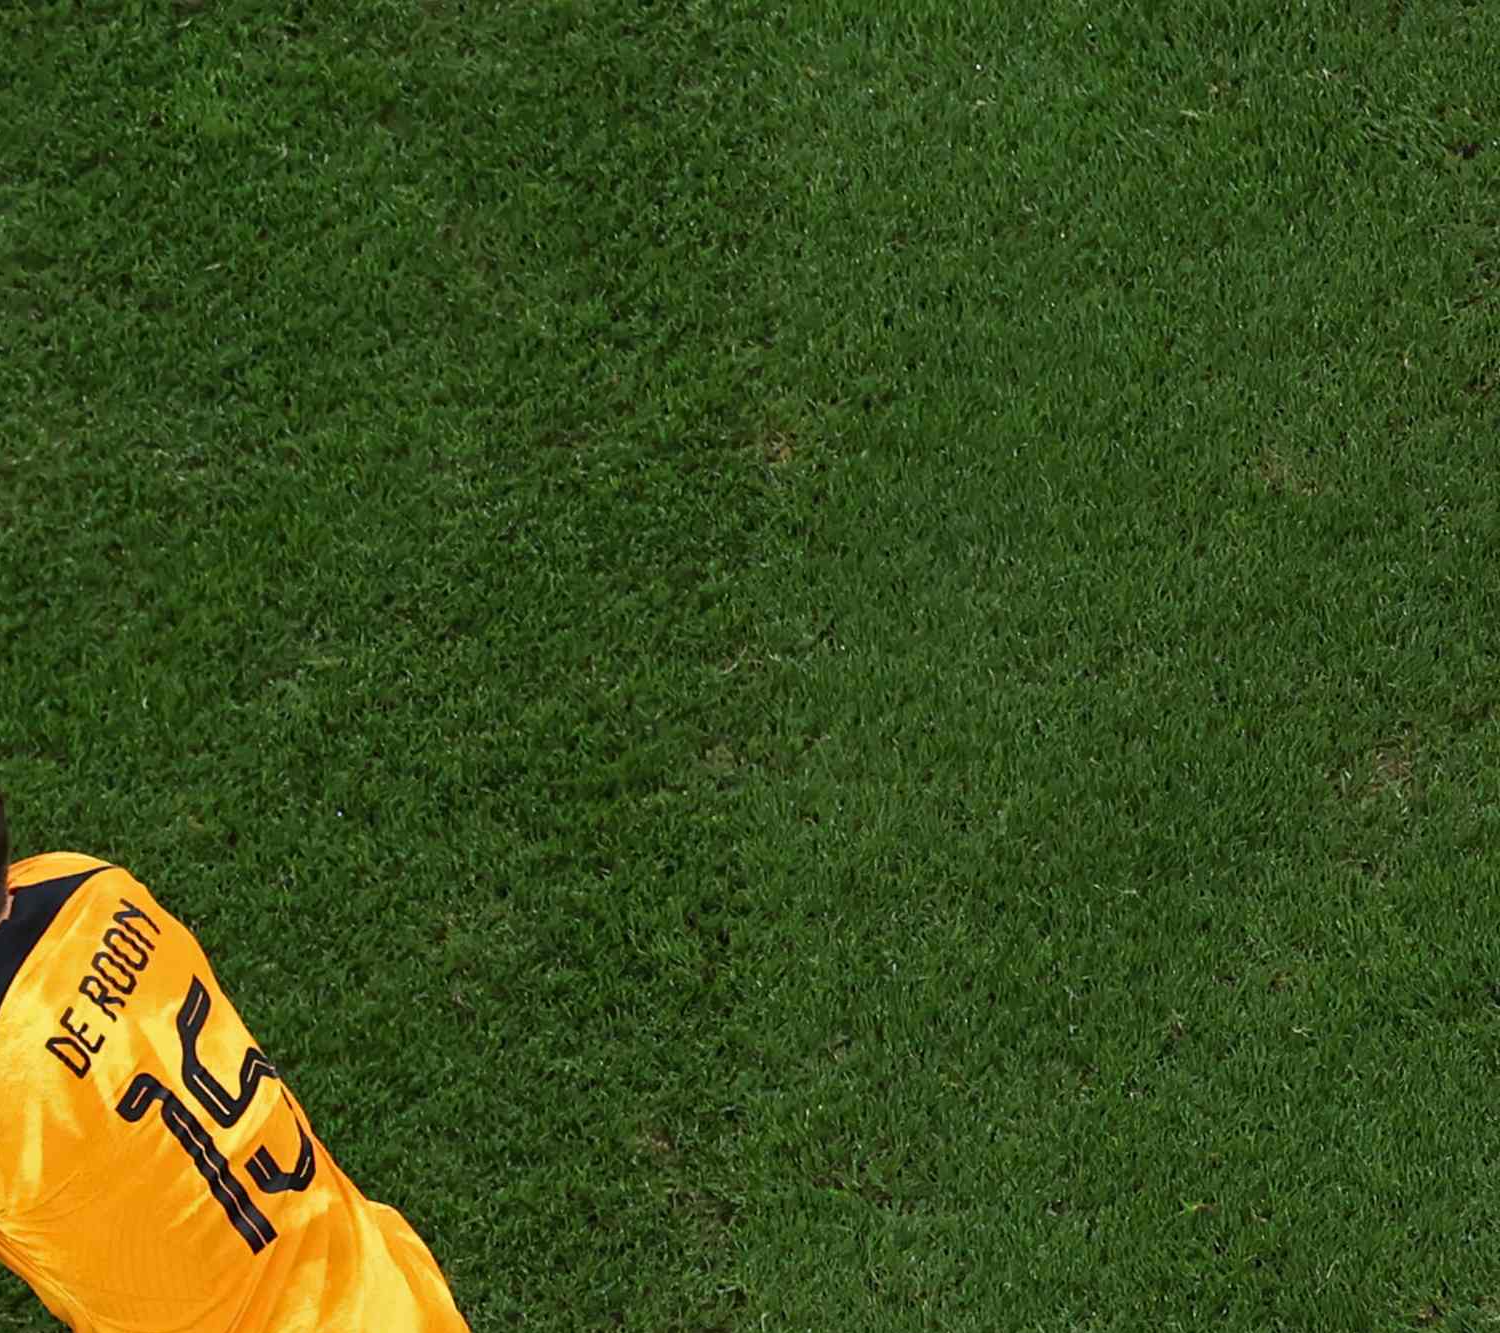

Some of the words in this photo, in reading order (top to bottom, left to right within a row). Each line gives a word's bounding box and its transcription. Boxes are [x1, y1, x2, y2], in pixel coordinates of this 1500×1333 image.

[45, 1006, 106, 1080] DE
[77, 897, 162, 1024] ROON
[114, 973, 317, 1257] 15
